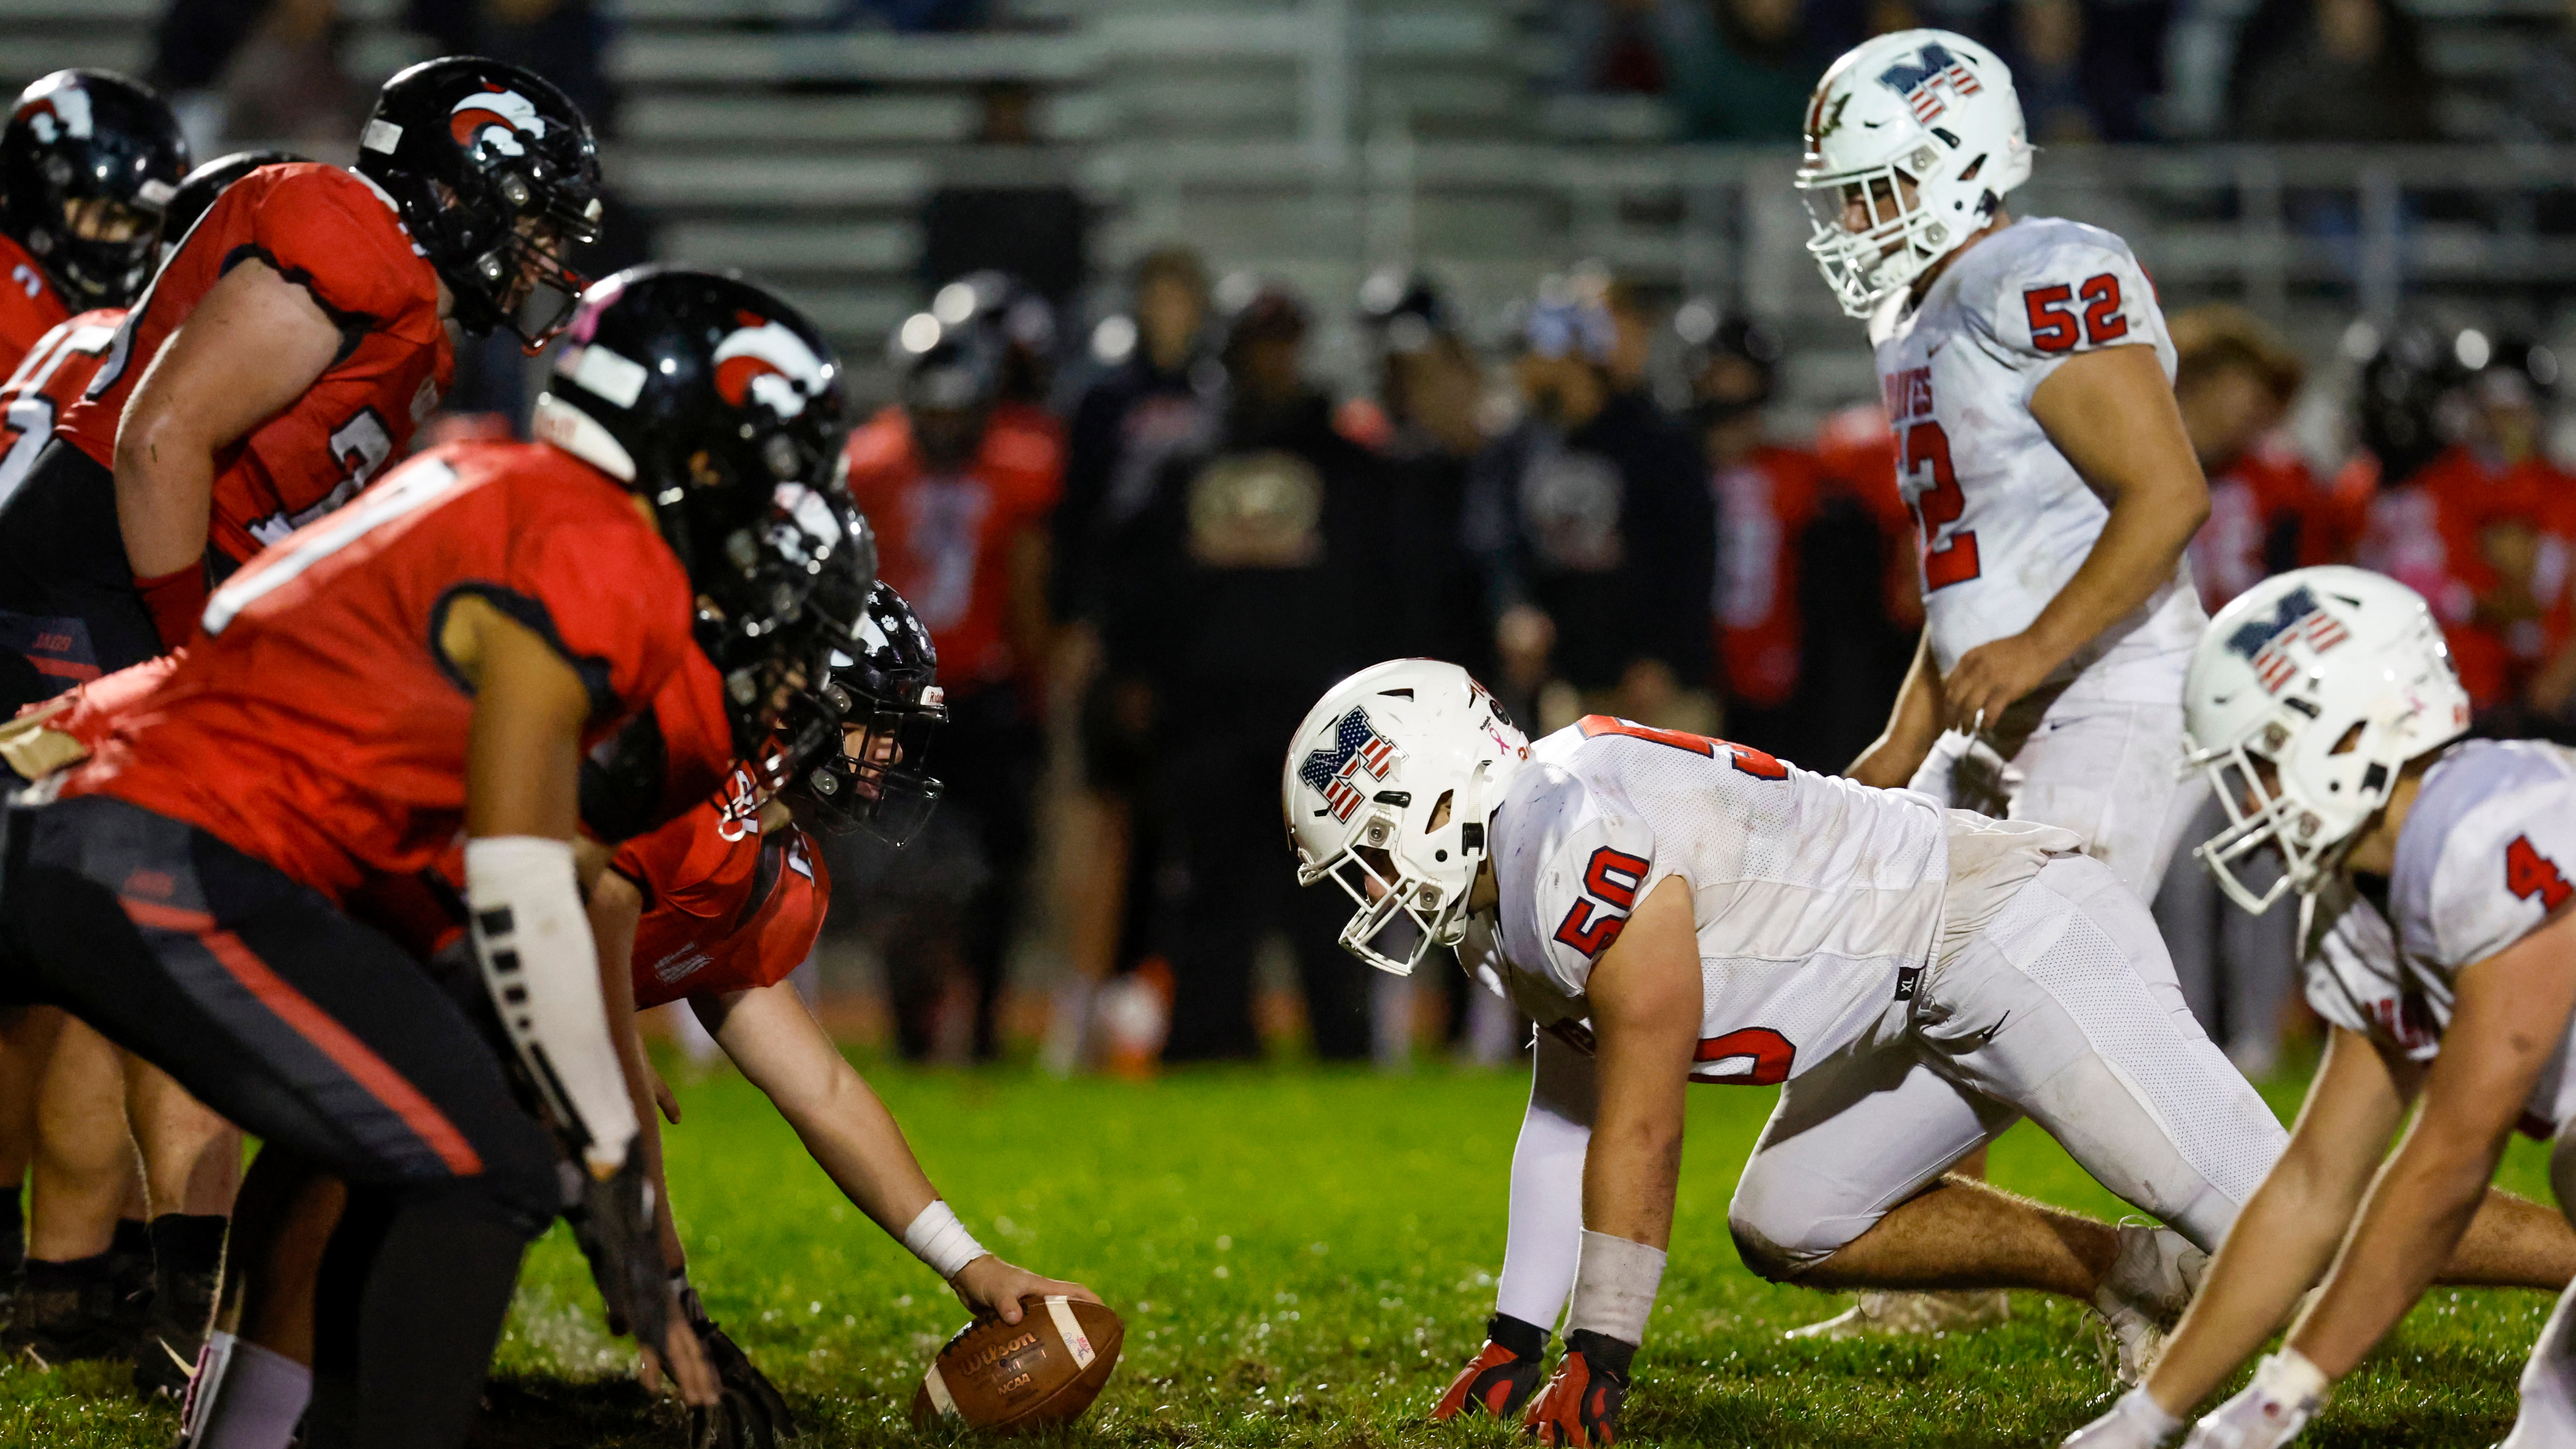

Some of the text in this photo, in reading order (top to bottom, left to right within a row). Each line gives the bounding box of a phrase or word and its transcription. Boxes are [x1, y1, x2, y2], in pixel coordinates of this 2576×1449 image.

[1874, 40, 1984, 128] M
[2023, 272, 2128, 352] 52
[1298, 705, 1409, 826] M
[1553, 845, 1650, 960] 50
[2506, 833, 2574, 913] 4
[1901, 976, 1915, 993] XL
[964, 1332, 1037, 1375] Wilson
[997, 1373, 1031, 1395] NCAA
